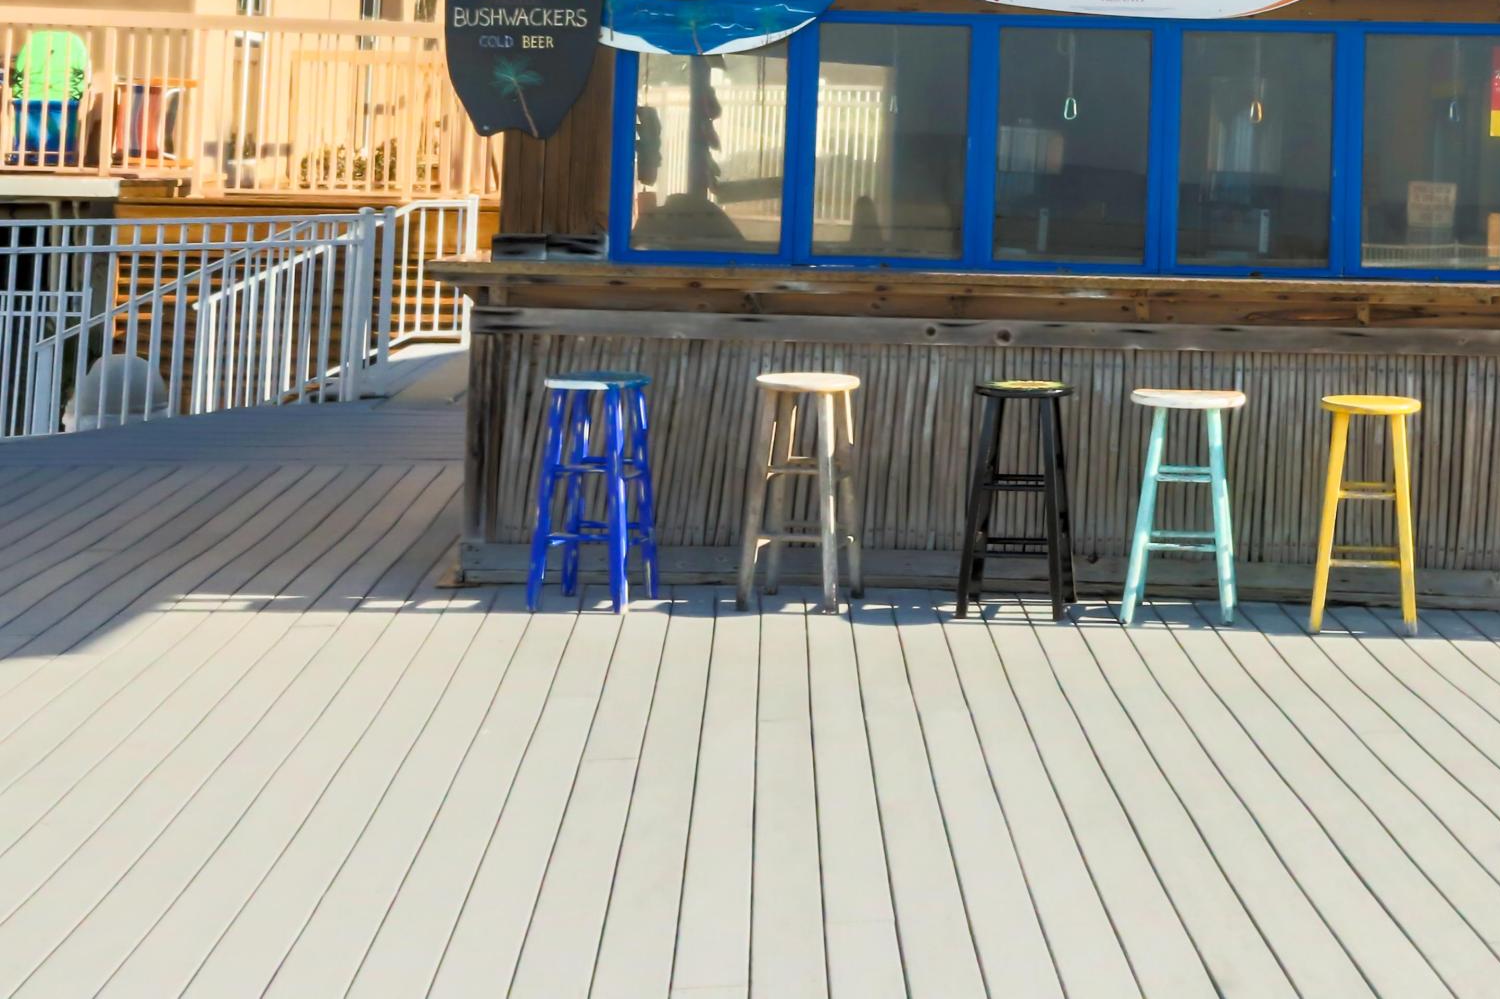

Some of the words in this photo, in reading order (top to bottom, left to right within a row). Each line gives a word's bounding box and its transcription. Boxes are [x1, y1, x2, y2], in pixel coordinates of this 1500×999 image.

[453, 6, 588, 28] BUSHWACKERS
[479, 35, 514, 48] COLD
[521, 35, 554, 49] BEER
